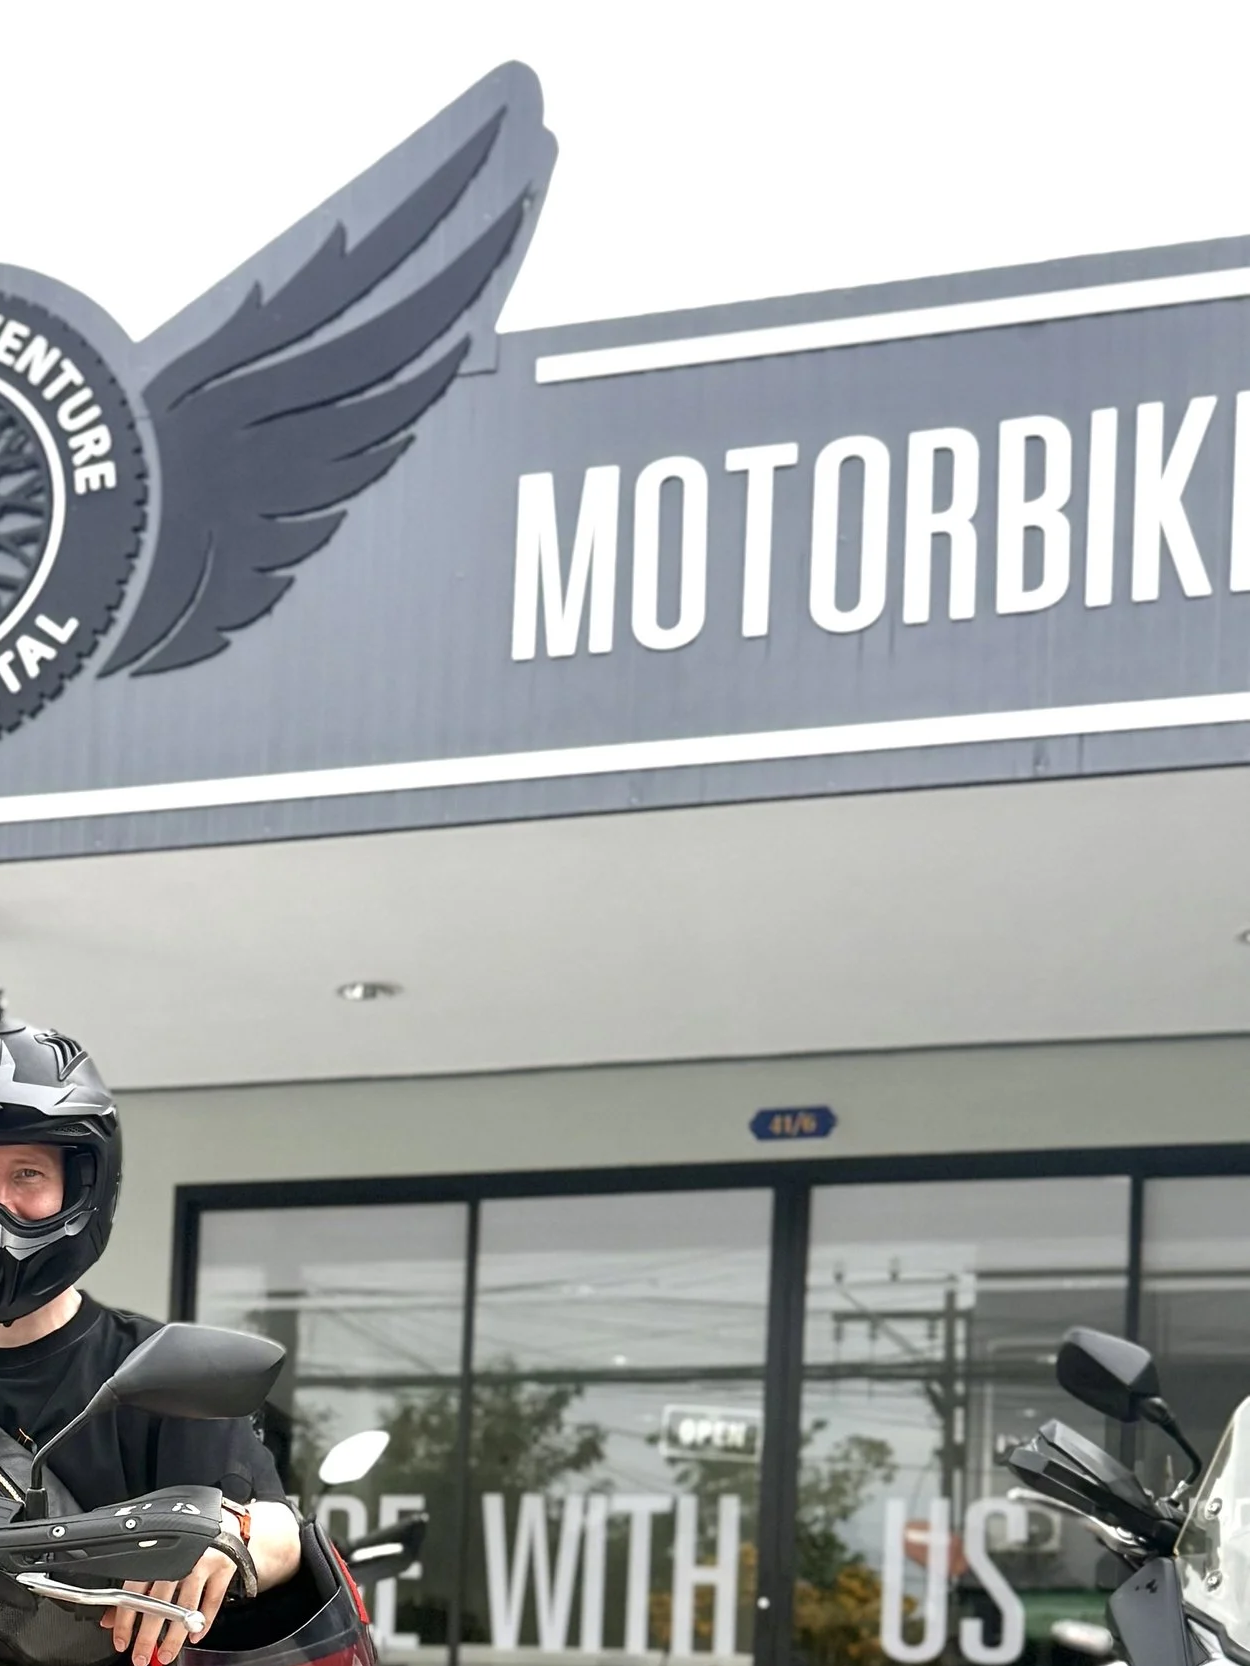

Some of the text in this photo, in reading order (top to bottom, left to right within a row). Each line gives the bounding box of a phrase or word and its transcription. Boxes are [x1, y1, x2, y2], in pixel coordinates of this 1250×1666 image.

[678, 1418, 746, 1448] OPEN
[481, 1492, 743, 1657] WITH
[878, 1496, 1028, 1665] US
